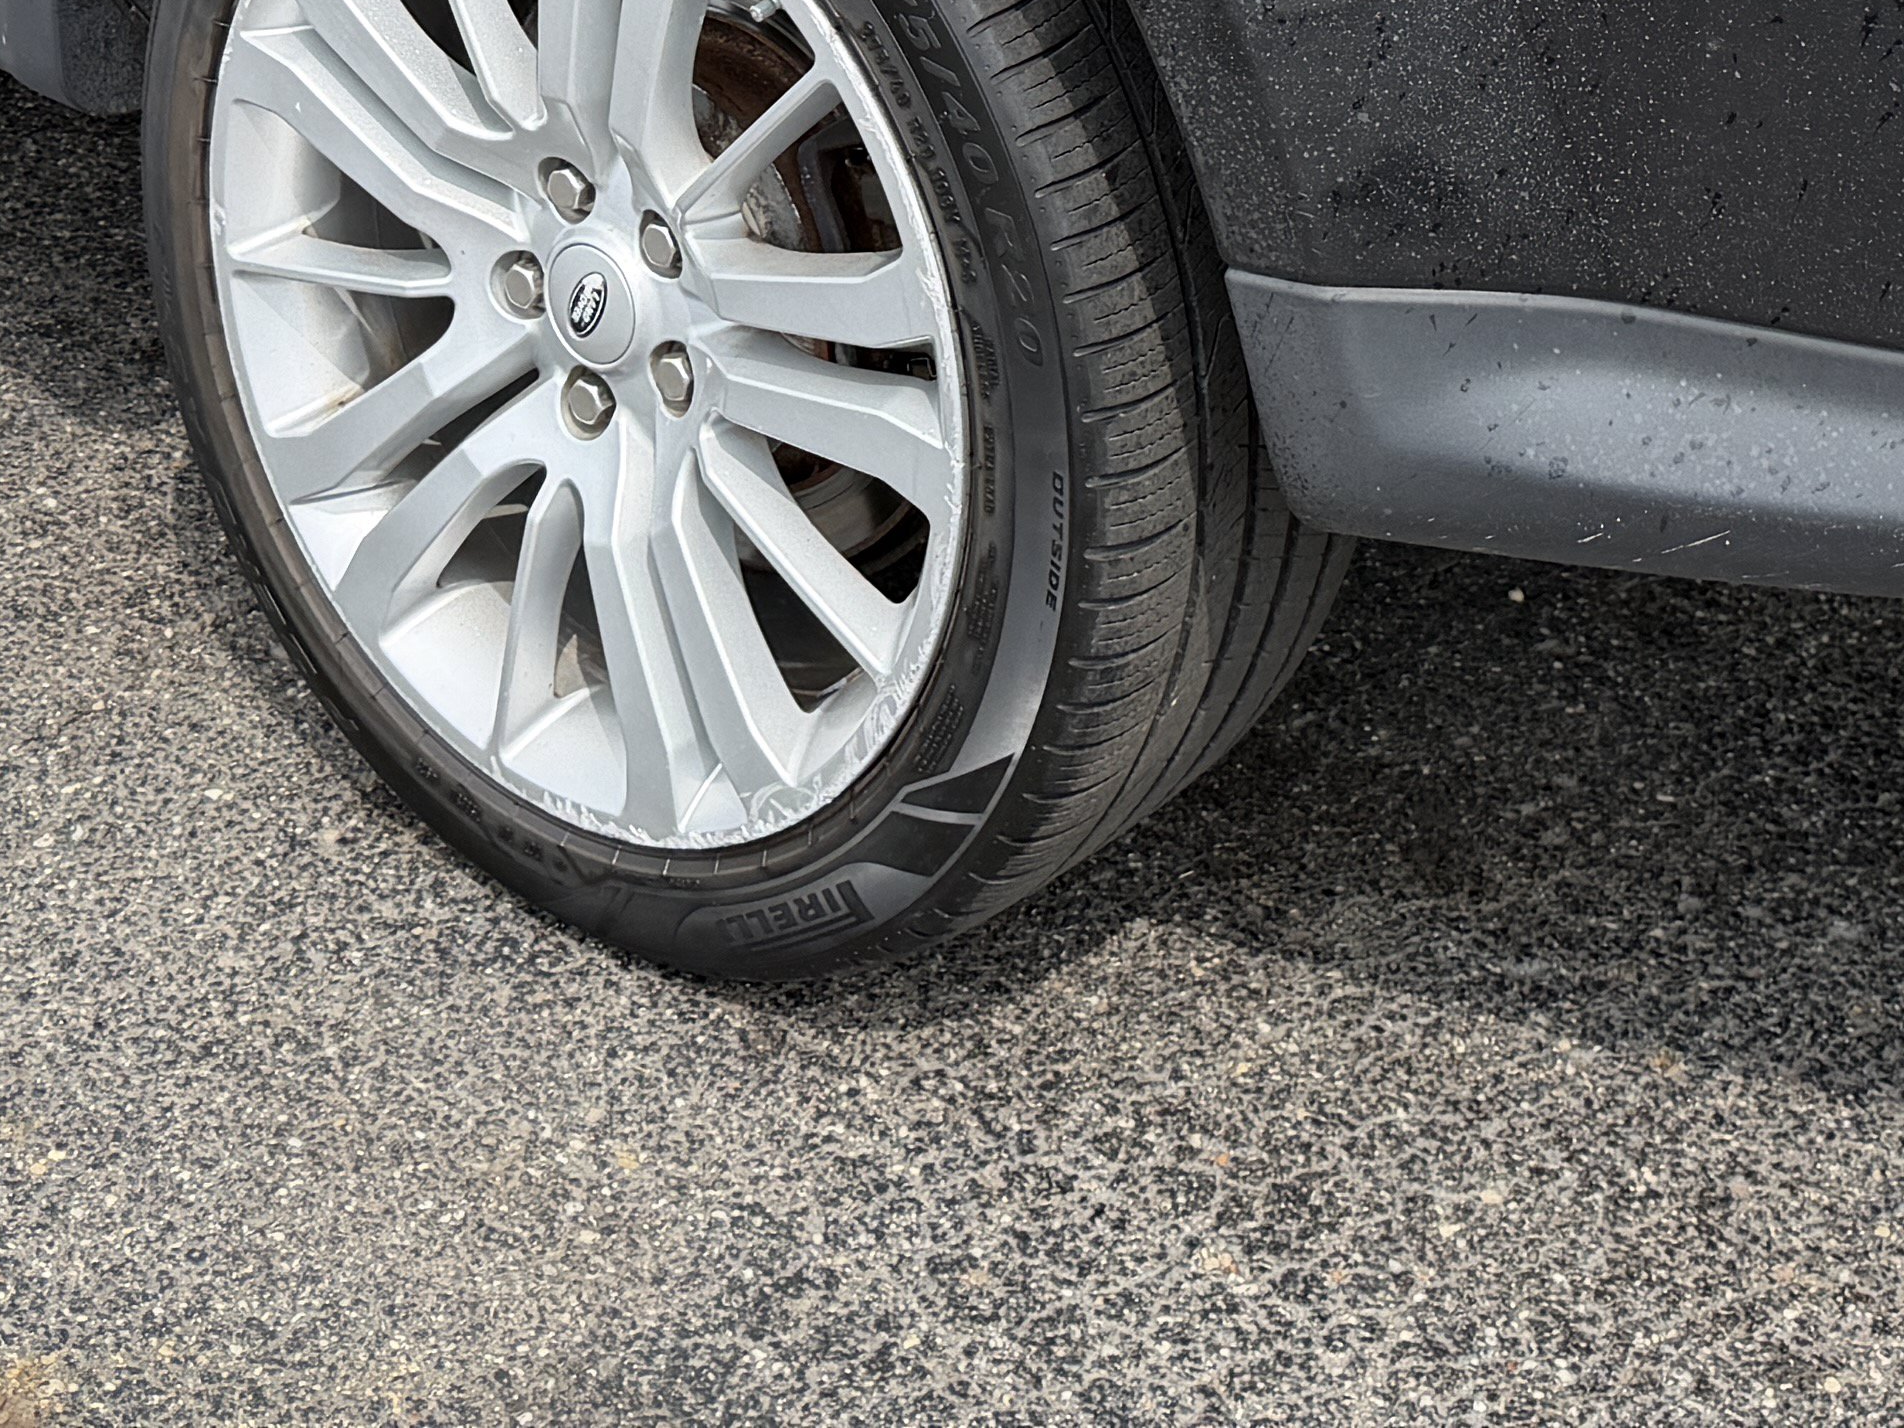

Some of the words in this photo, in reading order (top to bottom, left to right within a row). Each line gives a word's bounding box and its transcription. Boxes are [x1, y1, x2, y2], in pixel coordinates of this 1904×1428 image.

[983, 206, 1045, 367] R20
[1045, 470, 1065, 613] OUTSIDE
[714, 879, 876, 951] PIRELLI
